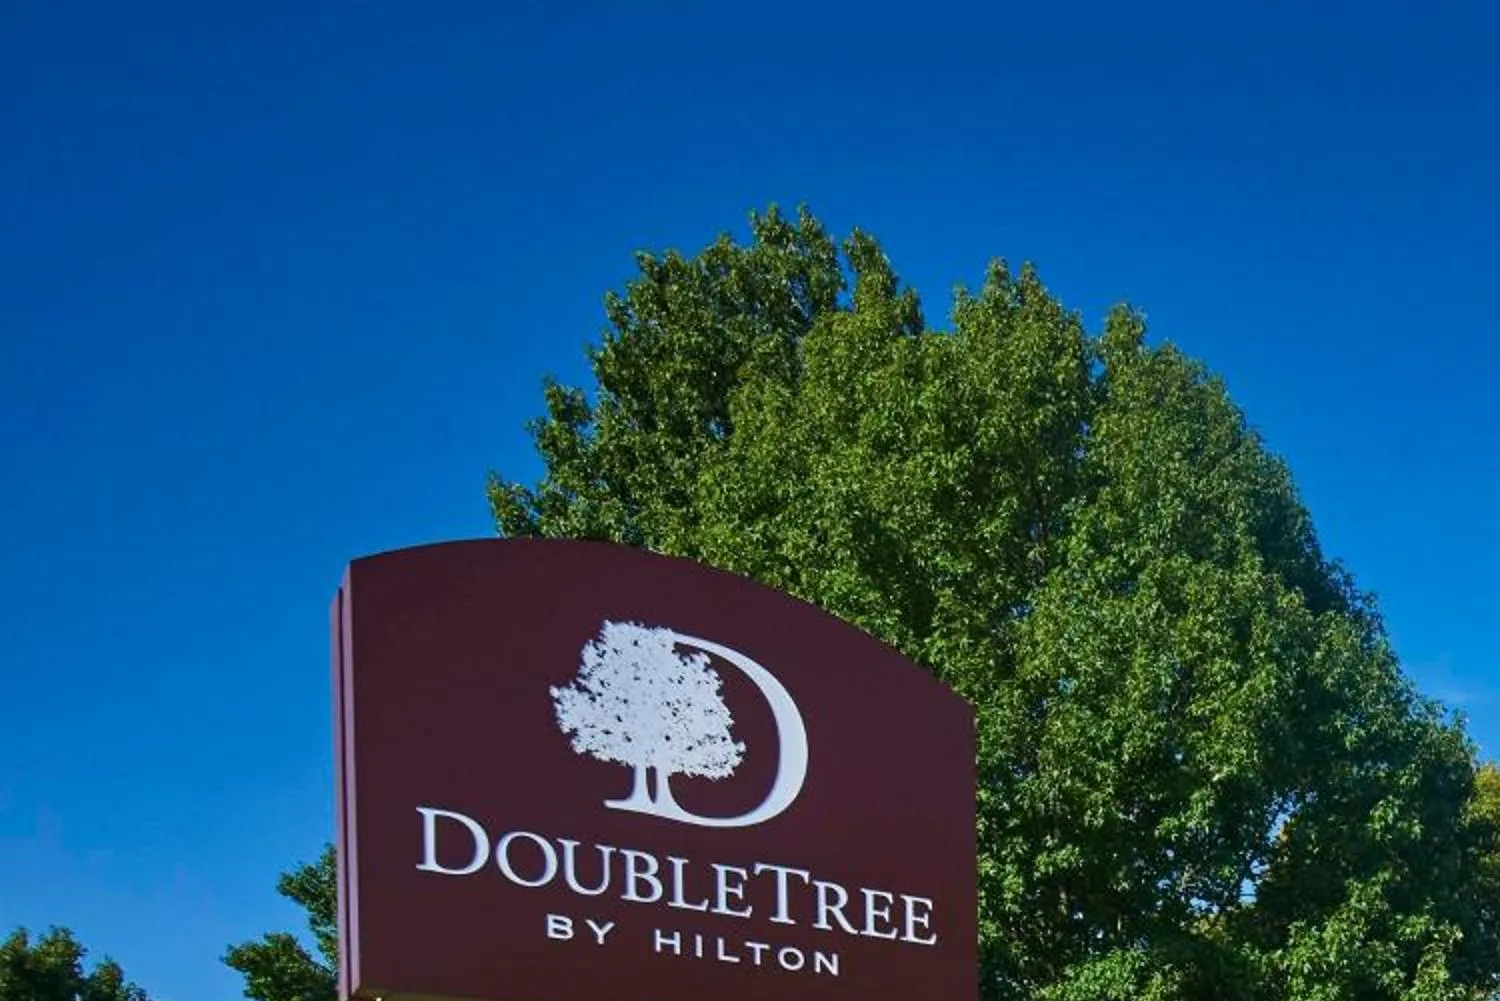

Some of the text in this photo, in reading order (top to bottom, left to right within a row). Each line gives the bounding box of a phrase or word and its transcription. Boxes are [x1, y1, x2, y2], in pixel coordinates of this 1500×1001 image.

[414, 805, 938, 946] DOUBLETREE
[545, 913, 841, 977] BY HILTON
